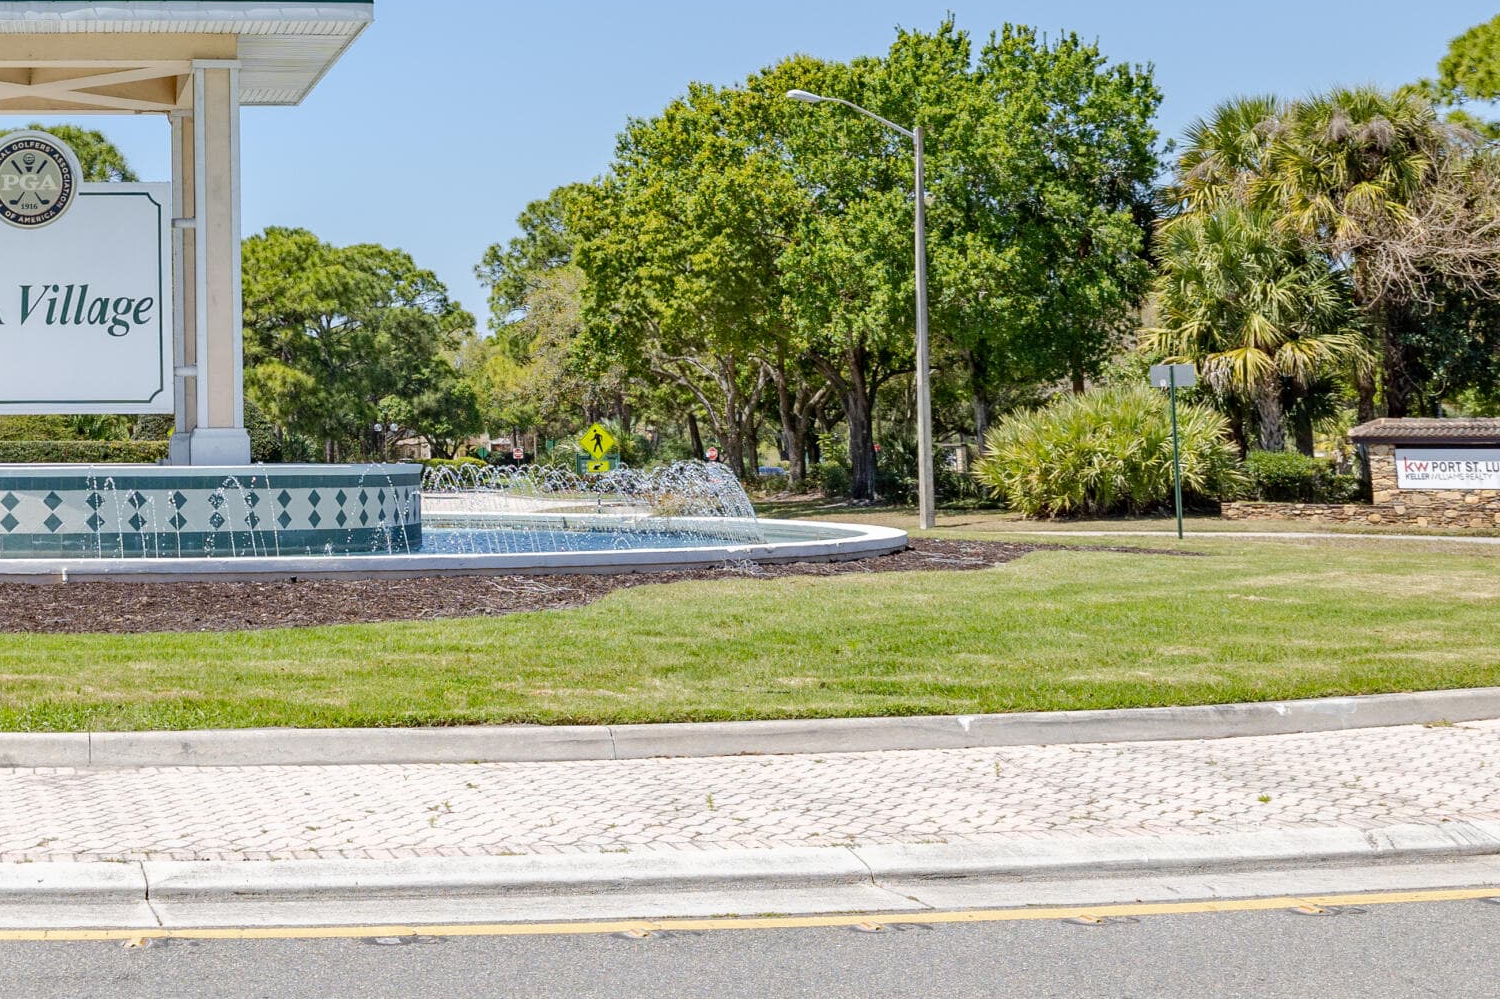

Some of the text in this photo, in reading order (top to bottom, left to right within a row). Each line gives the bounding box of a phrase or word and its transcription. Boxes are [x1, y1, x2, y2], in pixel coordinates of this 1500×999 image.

[1, 174, 59, 191] PGA
[53, 154, 71, 209] ASSOCIATION
[5, 211, 56, 223] OF AMERICA
[19, 283, 154, 337] Village
[1404, 457, 1429, 472] kw
[1432, 462, 1500, 472] PORT ST. LU
